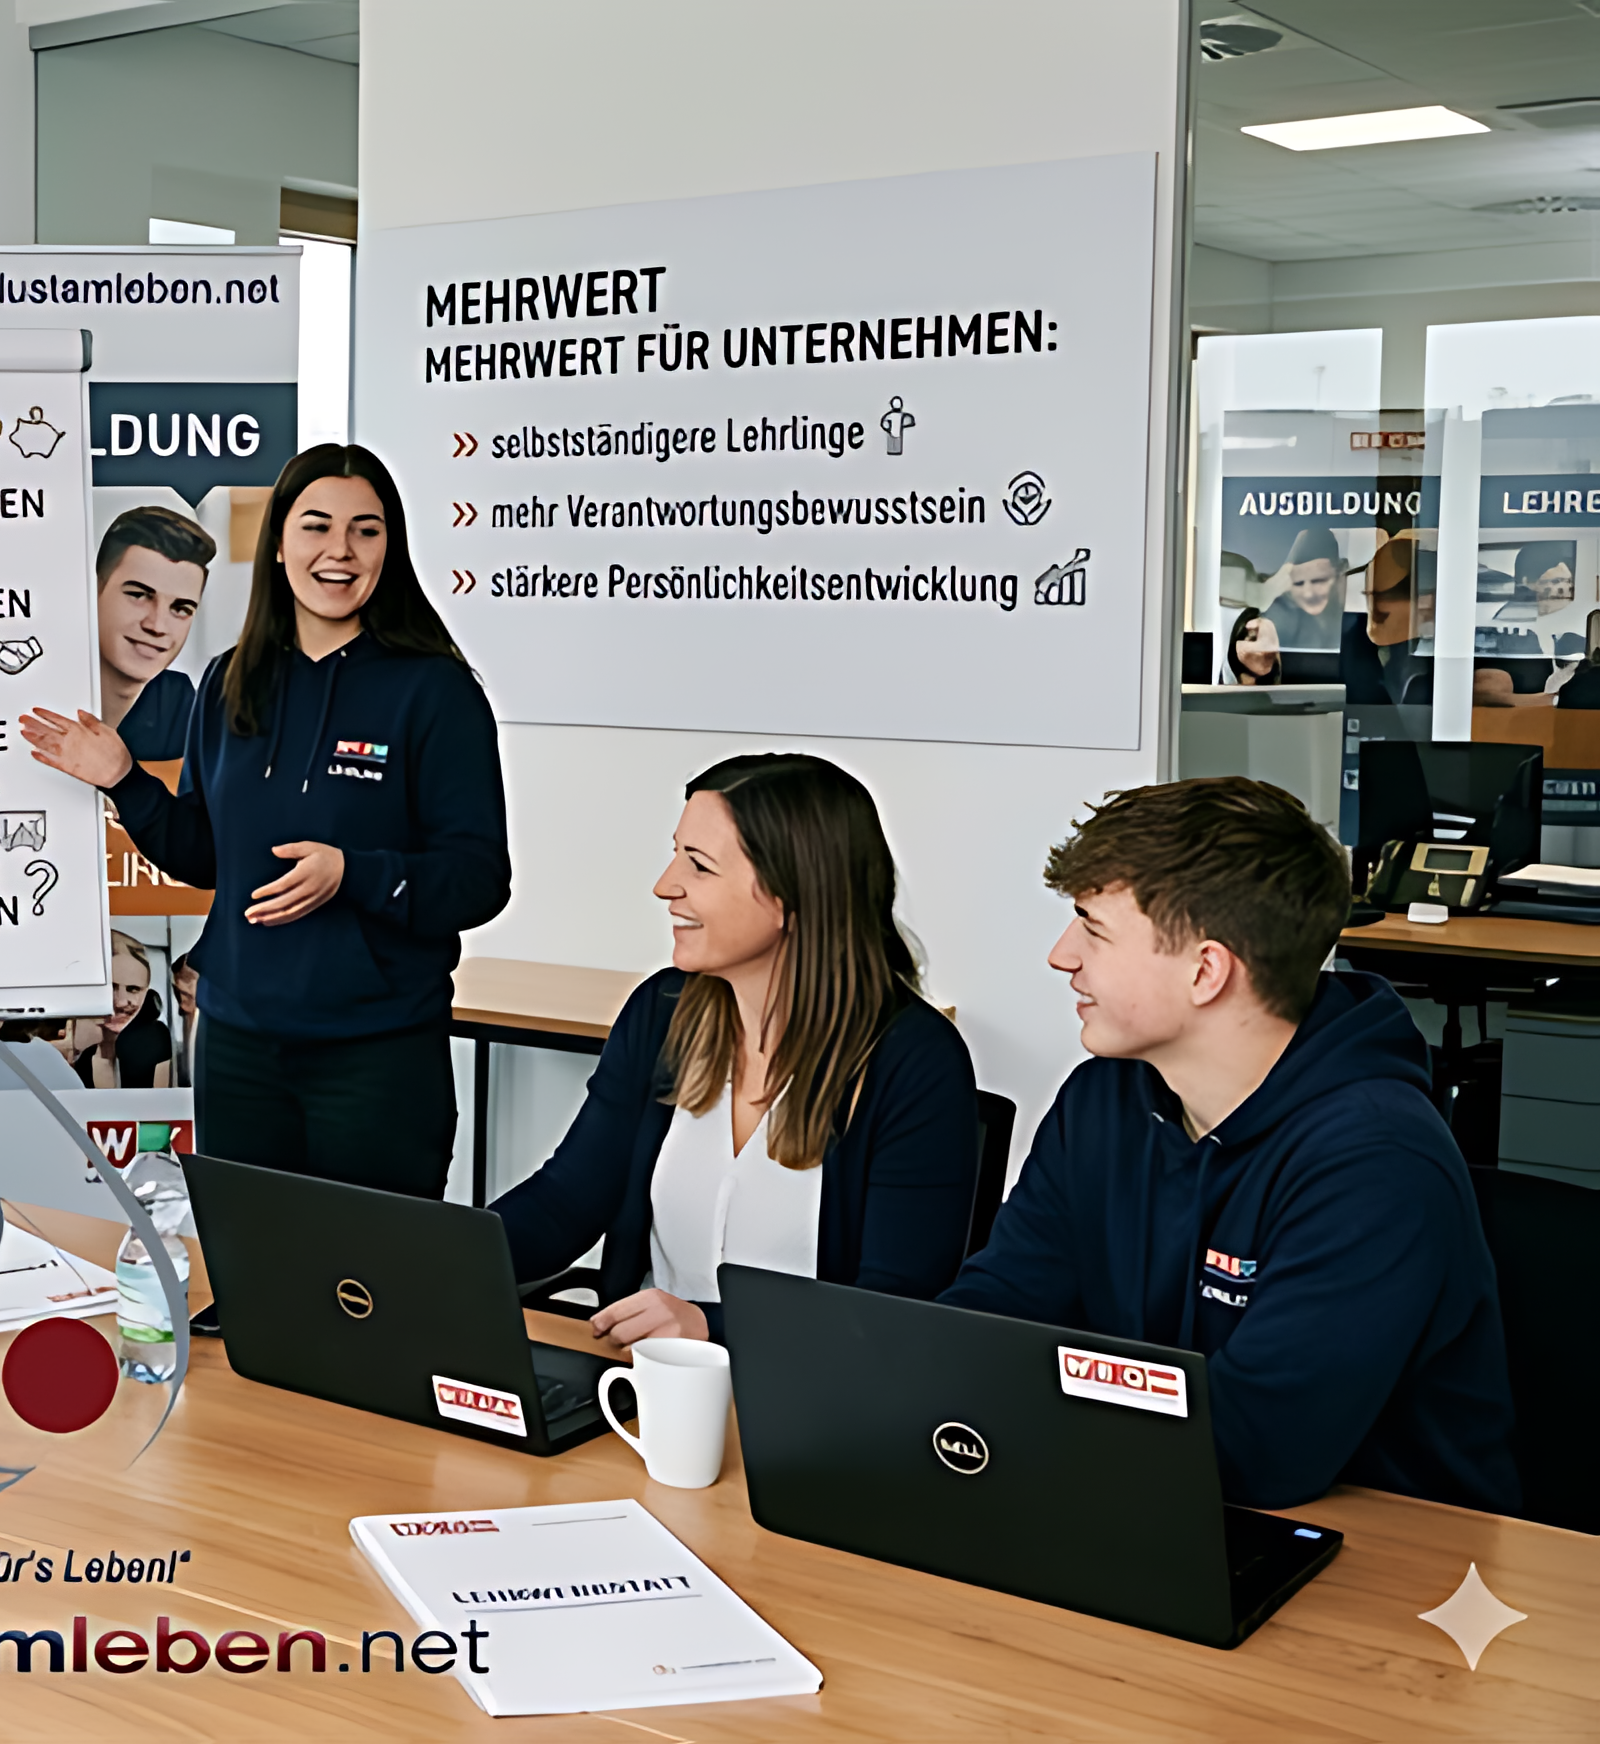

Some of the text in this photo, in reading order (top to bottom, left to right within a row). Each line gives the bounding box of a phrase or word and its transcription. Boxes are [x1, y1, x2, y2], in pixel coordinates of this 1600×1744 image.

[427, 267, 667, 328] MEHRWERT
[426, 310, 1057, 383] MEHRWERT FÜR UNTERNEHMEN:
[492, 416, 864, 462] selbstständigere Lehrlinge
[492, 487, 985, 534] mehr Verantwortungsbewusstsein
[492, 564, 1017, 611] stärkere Persönlichkeitsentwicklung
